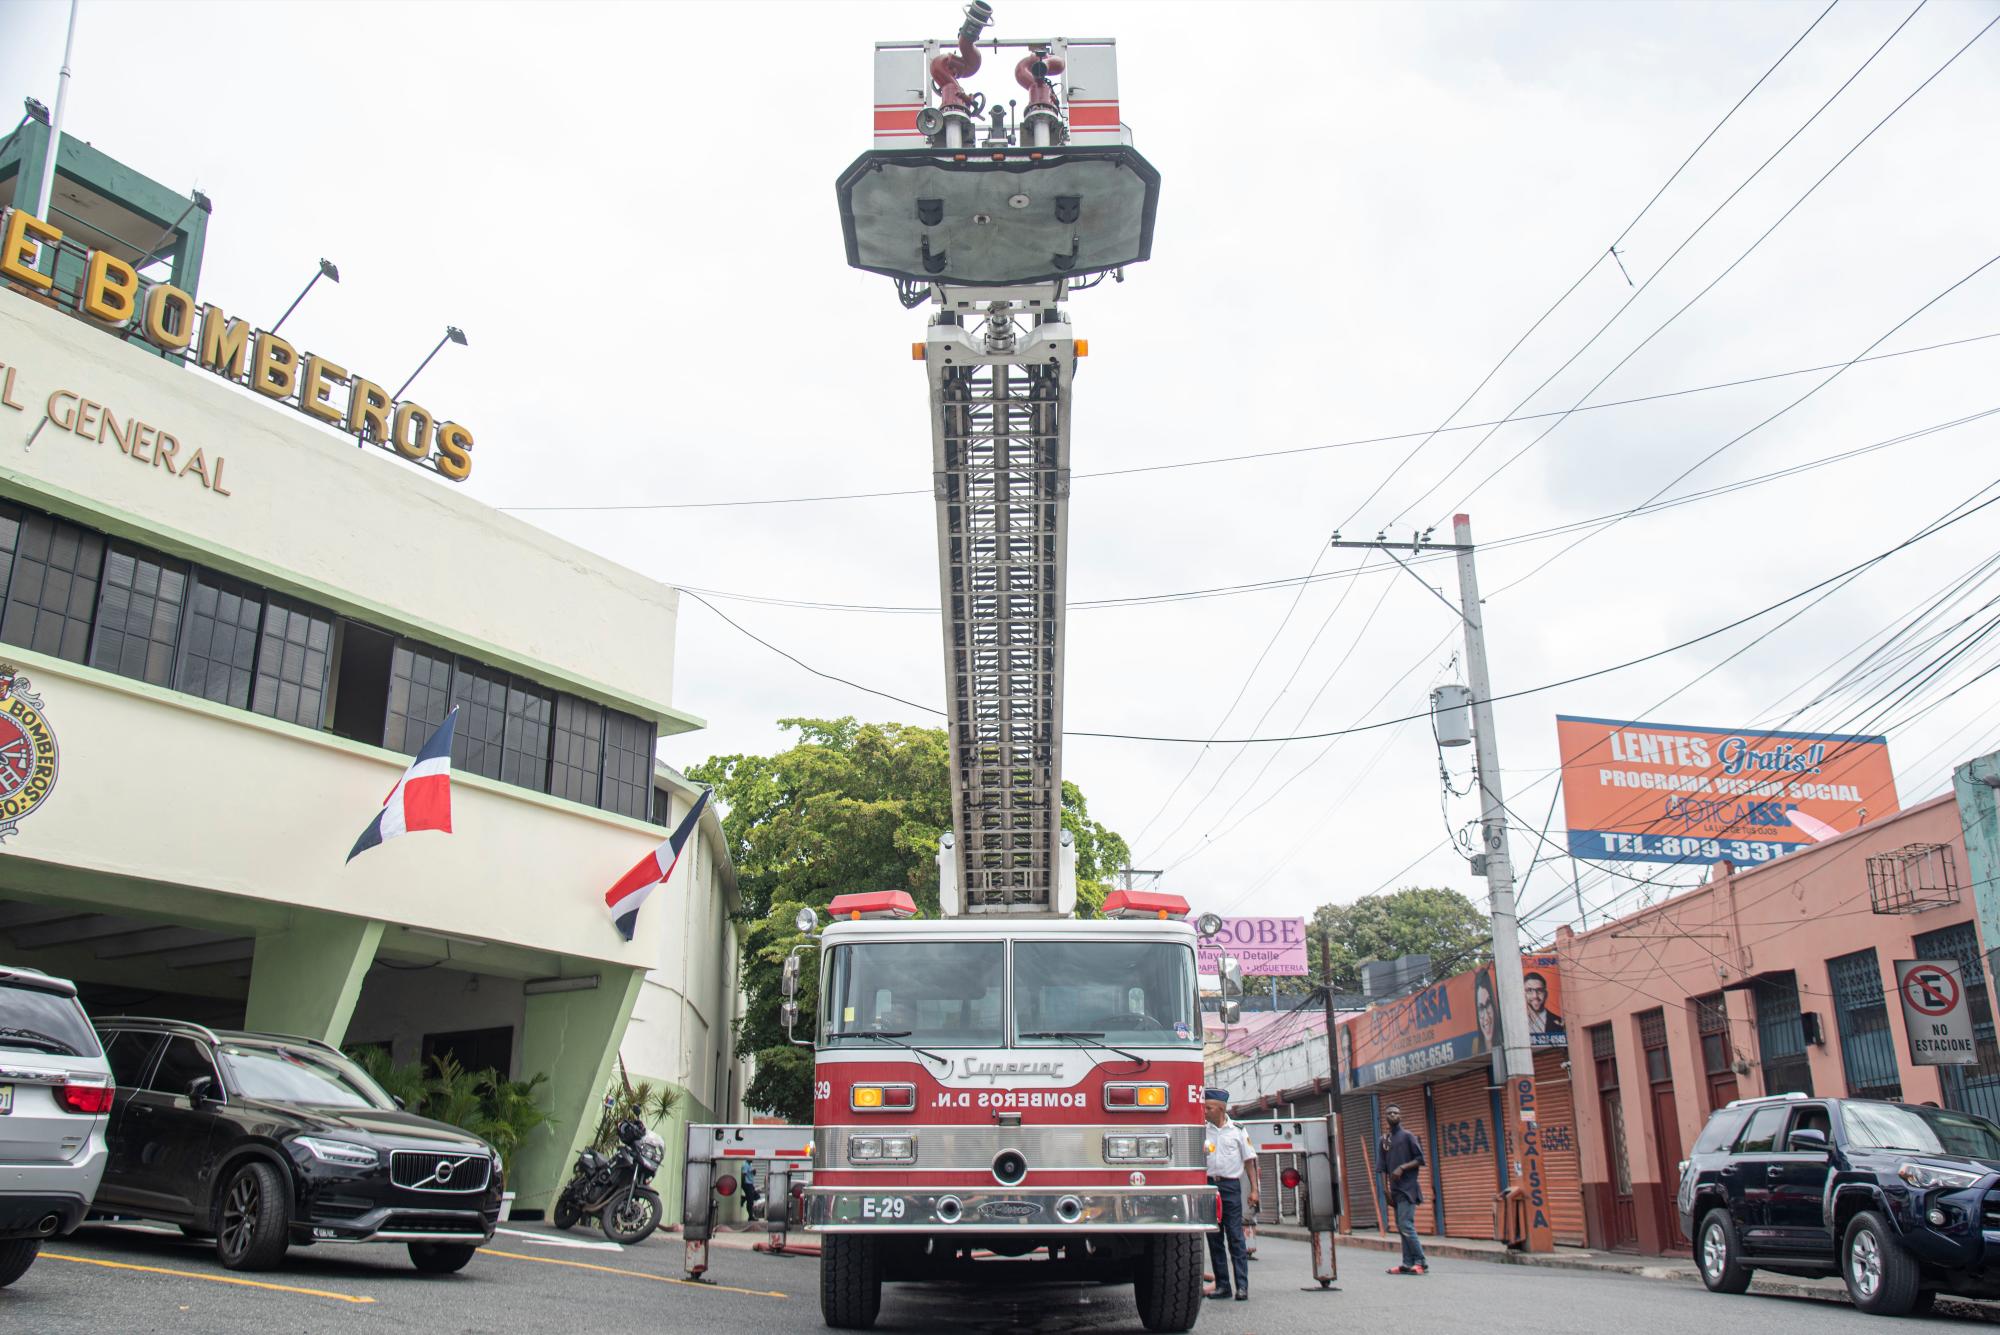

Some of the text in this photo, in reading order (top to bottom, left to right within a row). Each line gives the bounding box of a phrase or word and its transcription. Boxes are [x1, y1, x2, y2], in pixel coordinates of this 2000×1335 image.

[83, 248, 474, 482] BOMBEROS
[0, 361, 231, 496] L GENERAL
[9, 699, 54, 802] BOMBEROS
[1609, 731, 1824, 775] LENTES Gratis!!
[1600, 769, 1862, 802] PROGRAMA VISION SOCIAL
[1600, 833, 1809, 861] TEL.:809-331-
[1243, 951, 1279, 960] Detalle
[1252, 964, 1304, 972] JUGUETERIA
[1415, 984, 1452, 1029] ISSA
[1932, 1024, 1948, 1035] NO
[1914, 1039, 1972, 1052] ESTACIONE
[958, 1057, 1063, 1085] Superior
[815, 1081, 831, 1099] -29
[1441, 1119, 1490, 1157] ISSA
[863, 1198, 905, 1218] E-29
